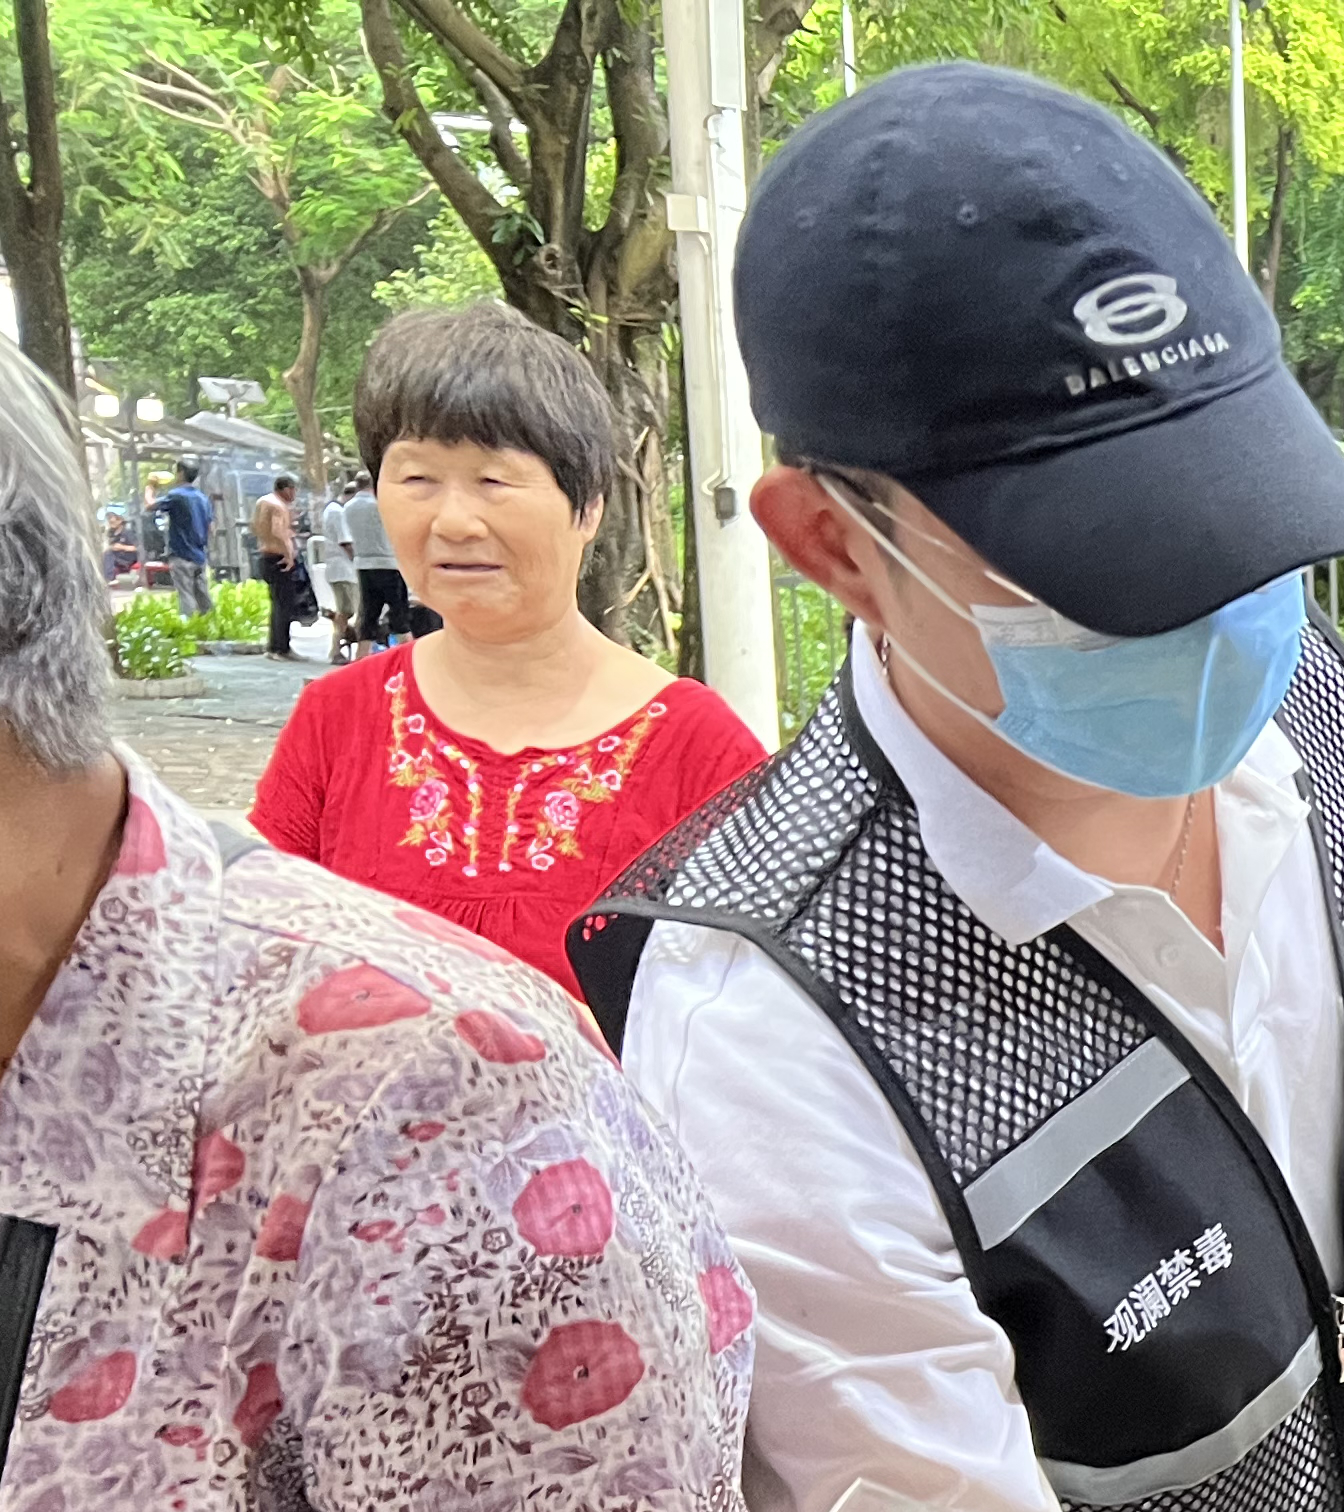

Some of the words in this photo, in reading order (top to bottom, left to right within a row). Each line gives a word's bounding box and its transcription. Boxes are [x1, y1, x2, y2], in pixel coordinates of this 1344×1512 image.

[1064, 332, 1230, 396] BALENCIAGA
[1103, 1222, 1234, 1353] 观澜禁毒
